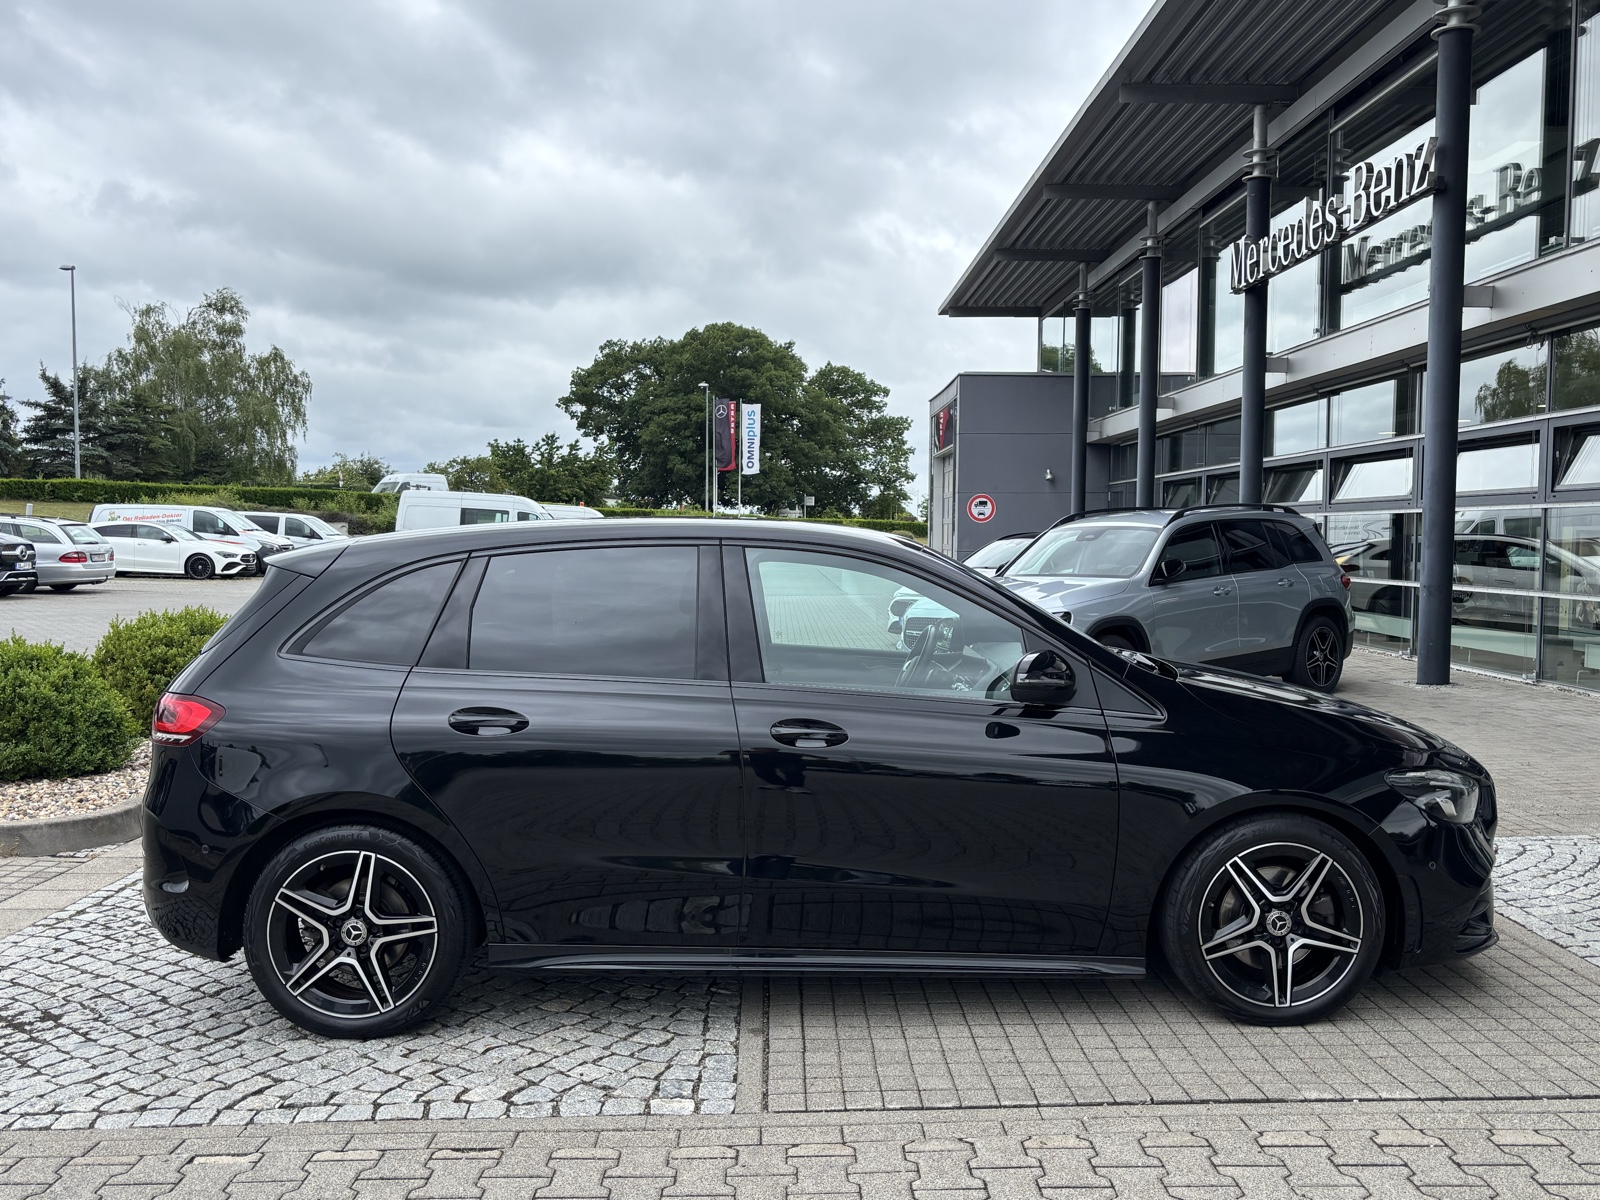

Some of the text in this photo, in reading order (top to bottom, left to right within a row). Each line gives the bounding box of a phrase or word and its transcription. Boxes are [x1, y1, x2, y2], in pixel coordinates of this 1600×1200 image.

[1229, 137, 1438, 292] Mercedes-Benz
[746, 410, 758, 469] OMNIplus
[303, 833, 363, 849] EcoContact 6
